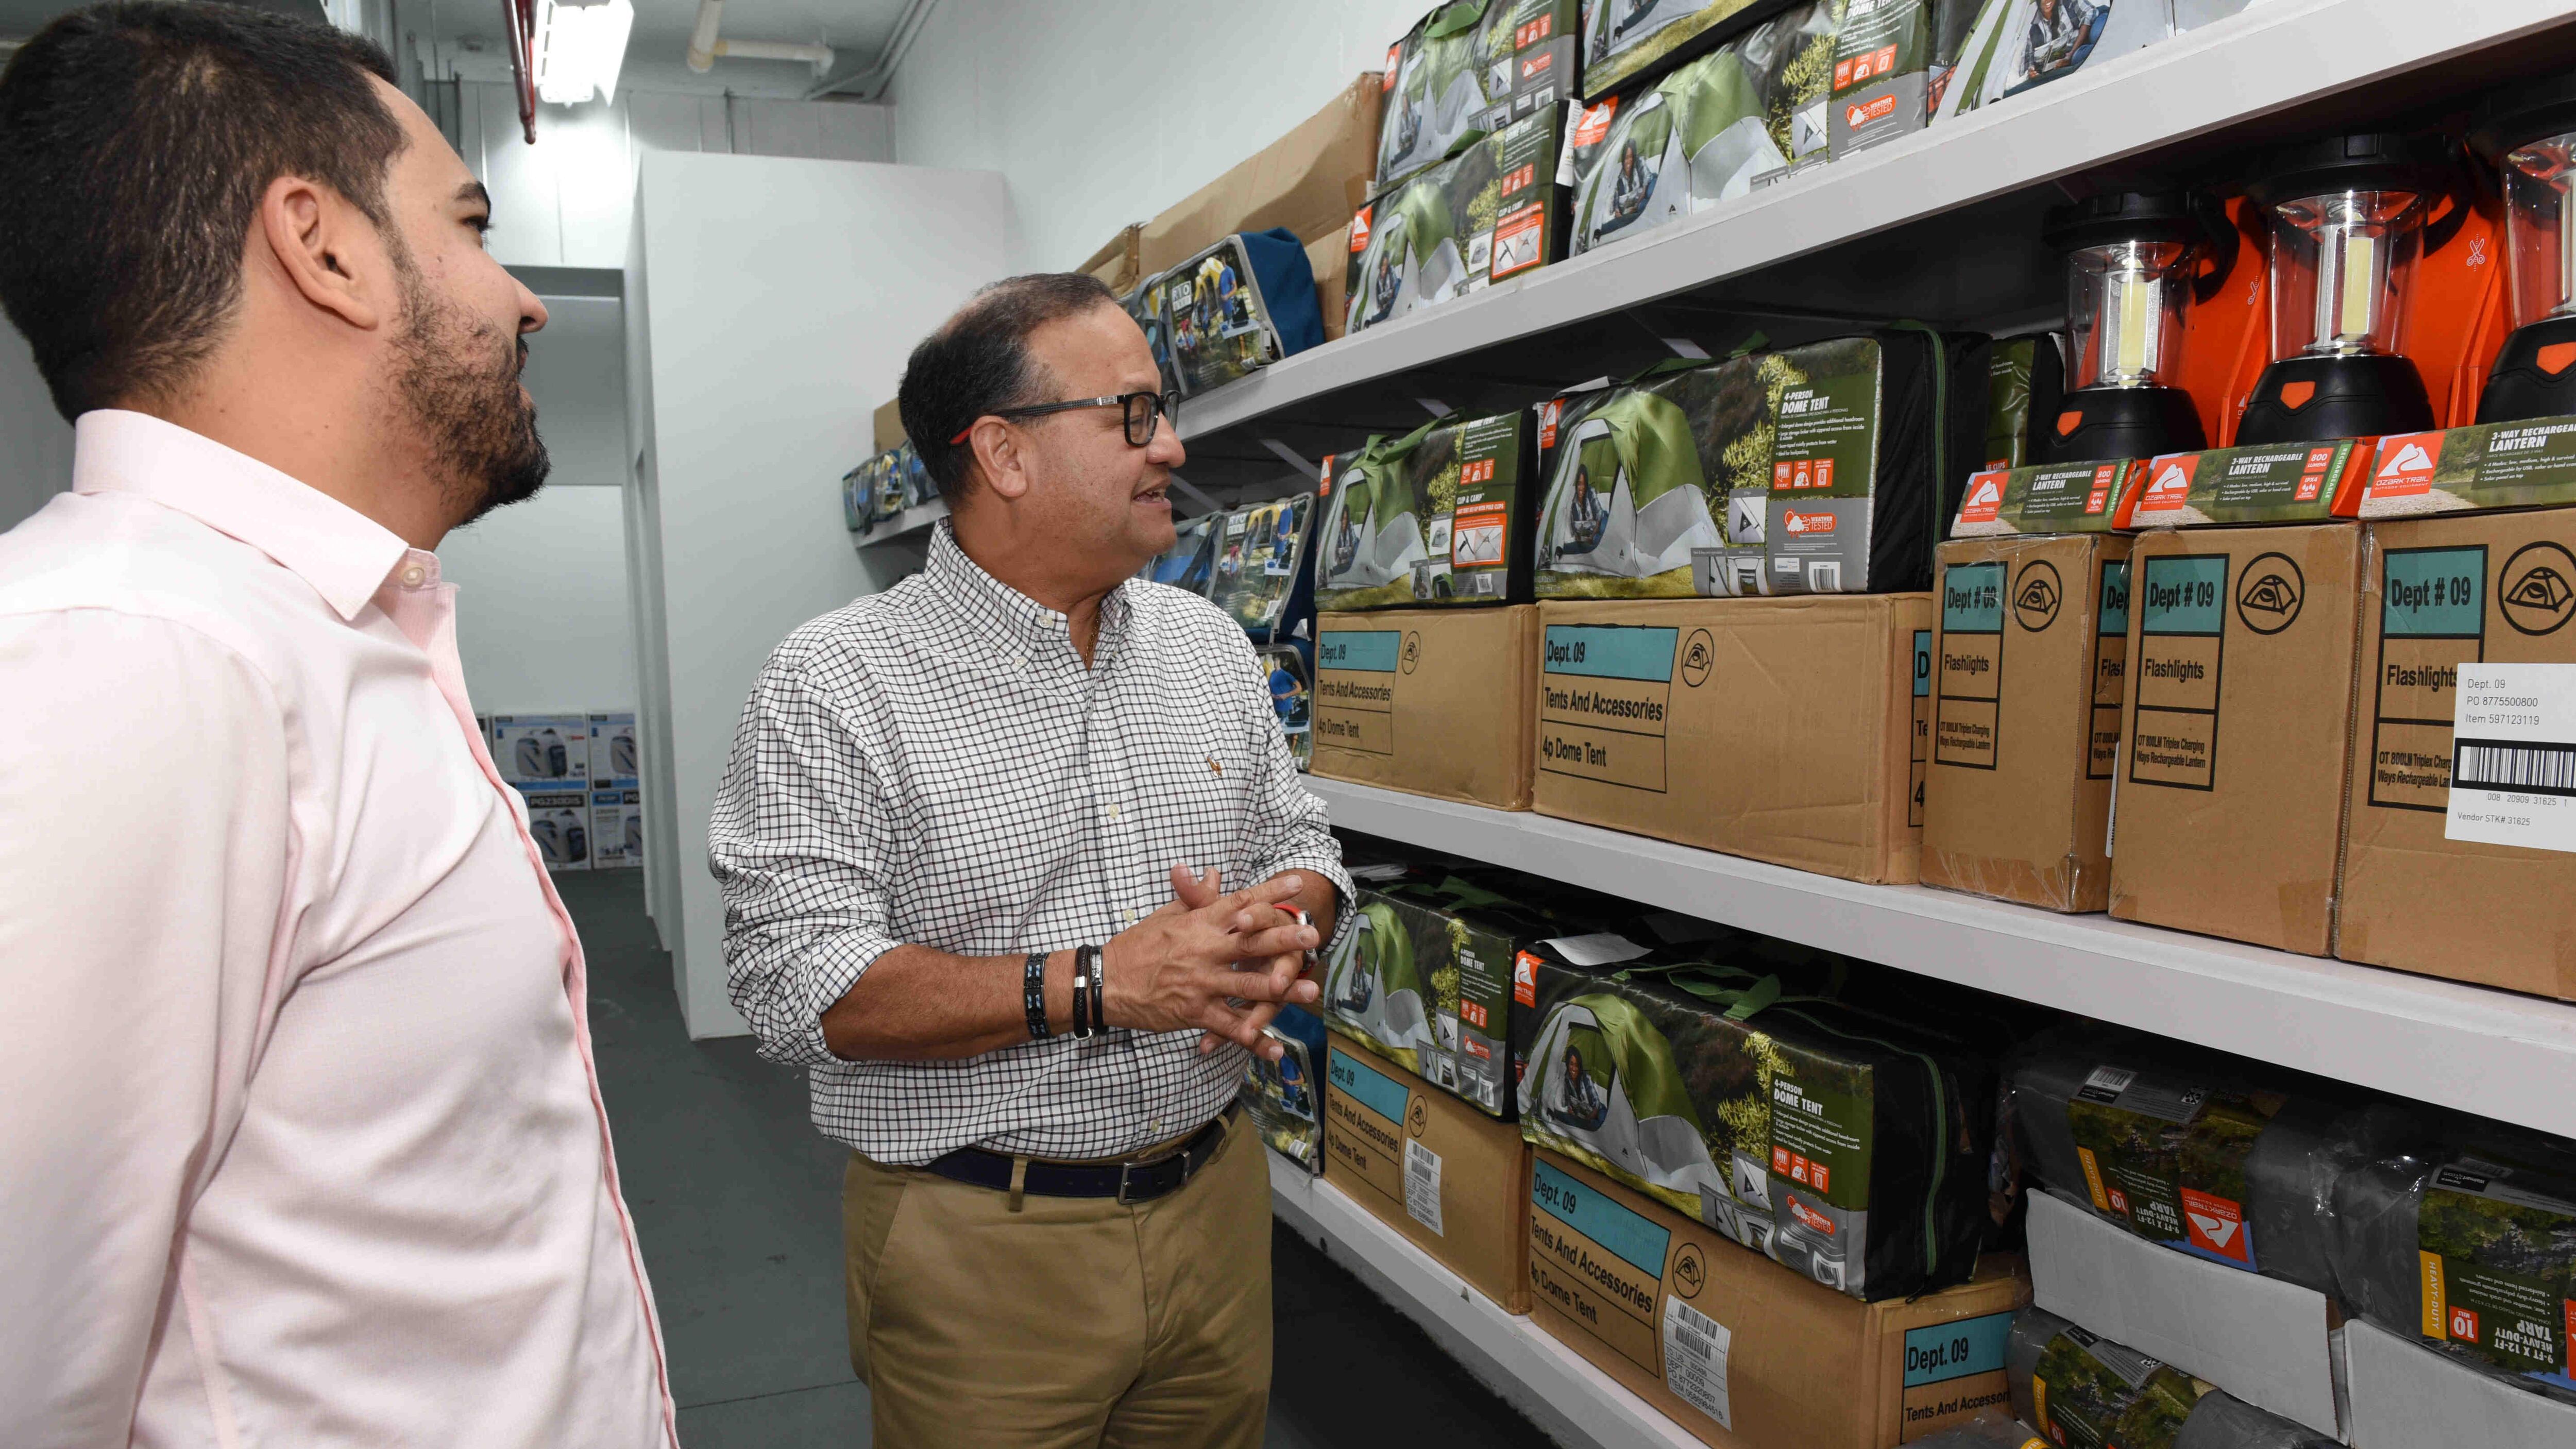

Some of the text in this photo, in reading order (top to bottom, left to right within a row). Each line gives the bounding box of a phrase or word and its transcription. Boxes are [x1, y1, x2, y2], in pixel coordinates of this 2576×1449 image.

[1870, 97, 1892, 108] WEATHER
[1870, 103, 1892, 116] TESTED
[1782, 400, 1808, 414] DOME
[1810, 396, 1829, 411] TENT
[1785, 390, 1813, 401] 4-PERSON
[2492, 424, 2576, 440] 3-WAY RECHARGEA
[2489, 435, 2547, 452] LANTERN
[2231, 453, 2304, 465] 3-WAY RECHARGEABLE
[2311, 453, 2328, 462] 800
[2035, 470, 2092, 481] 3-WAY RECHARGEABLE
[2097, 470, 2111, 478] 800
[2228, 463, 2271, 476] LANTERN
[2325, 447, 2348, 499] RECHARGEABLE
[2032, 479, 2066, 491] LANTERN
[2109, 464, 2127, 512] RECHARGEABLE
[1811, 521, 1833, 530] TESTED
[1948, 585, 1997, 614] Dept # 09
[2106, 585, 2129, 614] Dep
[2149, 581, 2214, 613] Dept # 09
[2392, 576, 2471, 614] Dept # 09
[1320, 644, 1346, 664] Dept. 09
[1547, 640, 1585, 667] Dept. 09
[1944, 654, 1989, 676] Flashlights
[2144, 659, 2205, 683] Flashlights
[1319, 679, 1391, 702] Tents And Accessories
[2468, 679, 2505, 692] Dept. 09
[1545, 686, 1663, 722] Tents And Accessories
[2467, 696, 2538, 707] PO 8775500800
[1318, 718, 1359, 738] 4p Dome Tent
[2466, 713, 2539, 726] Item 597123119
[1543, 736, 1606, 767] 4p Dome Tent
[2138, 735, 2205, 754] OT 800LM Triplex Charging
[2137, 750, 2206, 769] Ways Rechargeable Lantern
[2379, 751, 2391, 765] OT
[2391, 752, 2413, 767] 800LM
[2413, 752, 2434, 770] Triplex
[2377, 769, 2438, 789] Ways Rechargeable
[2487, 793, 2568, 807] 008 20909 31625 1
[2458, 812, 2531, 827] Vendor STK# 31625
[1331, 1058, 1355, 1087] Dept. 09
[1774, 1079, 1803, 1096] 4-PERSON
[1774, 1088, 1823, 1116] DOME TENT
[1328, 1093, 1398, 1153] Tents And Accessories
[1335, 1135, 1351, 1159] Dome
[1352, 1146, 1367, 1170] Tent
[2084, 1154, 2104, 1204] HEAVY-DUTY
[1534, 1172, 1577, 1215] Dept. 09
[2111, 1194, 2125, 1210] 10
[1812, 1212, 1831, 1226] WEATHER
[2136, 1206, 2179, 1225] HEAVY-DUTY
[2149, 1201, 2177, 1217] TARP
[1811, 1218, 1831, 1233] TESTED
[2137, 1214, 2180, 1235] 9-FT X 12-FT
[1532, 1215, 1652, 1313] Tents And Accessories
[1541, 1270, 1570, 1306] Dome
[1572, 1290, 1598, 1325] Tent
[2429, 1261, 2439, 1330] HEAVY-DUTY
[2457, 1310, 2471, 1319] MILS
[2453, 1316, 2475, 1339] 10
[2516, 1319, 2552, 1341] TARP
[2495, 1327, 2553, 1354] HEAVY-DUTY
[1908, 1337, 1969, 1374] Dept. 09
[2494, 1338, 2554, 1364] 9-FT X 12-FT
[1905, 1406, 1935, 1422] Tents
[1937, 1397, 1958, 1416] And
